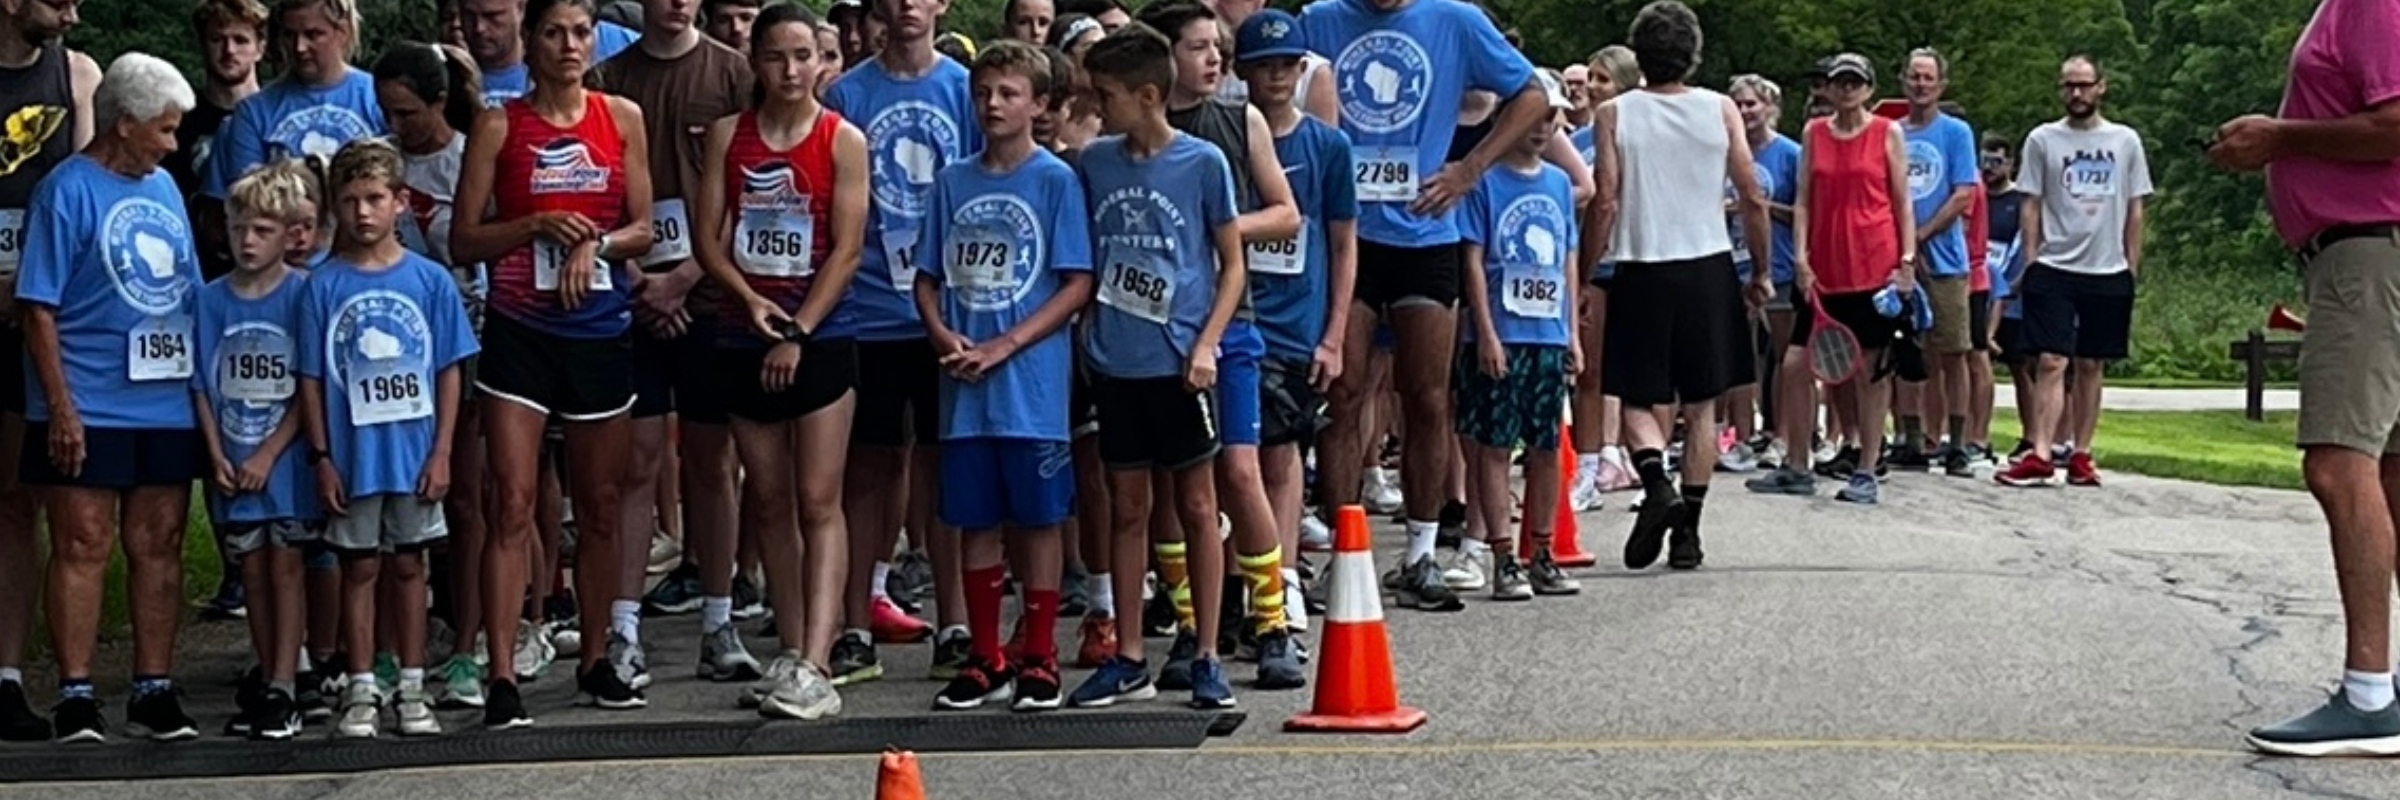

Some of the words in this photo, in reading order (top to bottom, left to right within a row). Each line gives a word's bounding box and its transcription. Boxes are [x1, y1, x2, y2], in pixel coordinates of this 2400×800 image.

[1148, 189, 1185, 228] POINT
[746, 229, 802, 257] 1356
[956, 241, 1008, 267] 1973
[1512, 278, 1557, 301] 1362
[137, 332, 186, 359] 1964
[228, 352, 286, 380] 1965
[358, 372, 420, 404] 1966
